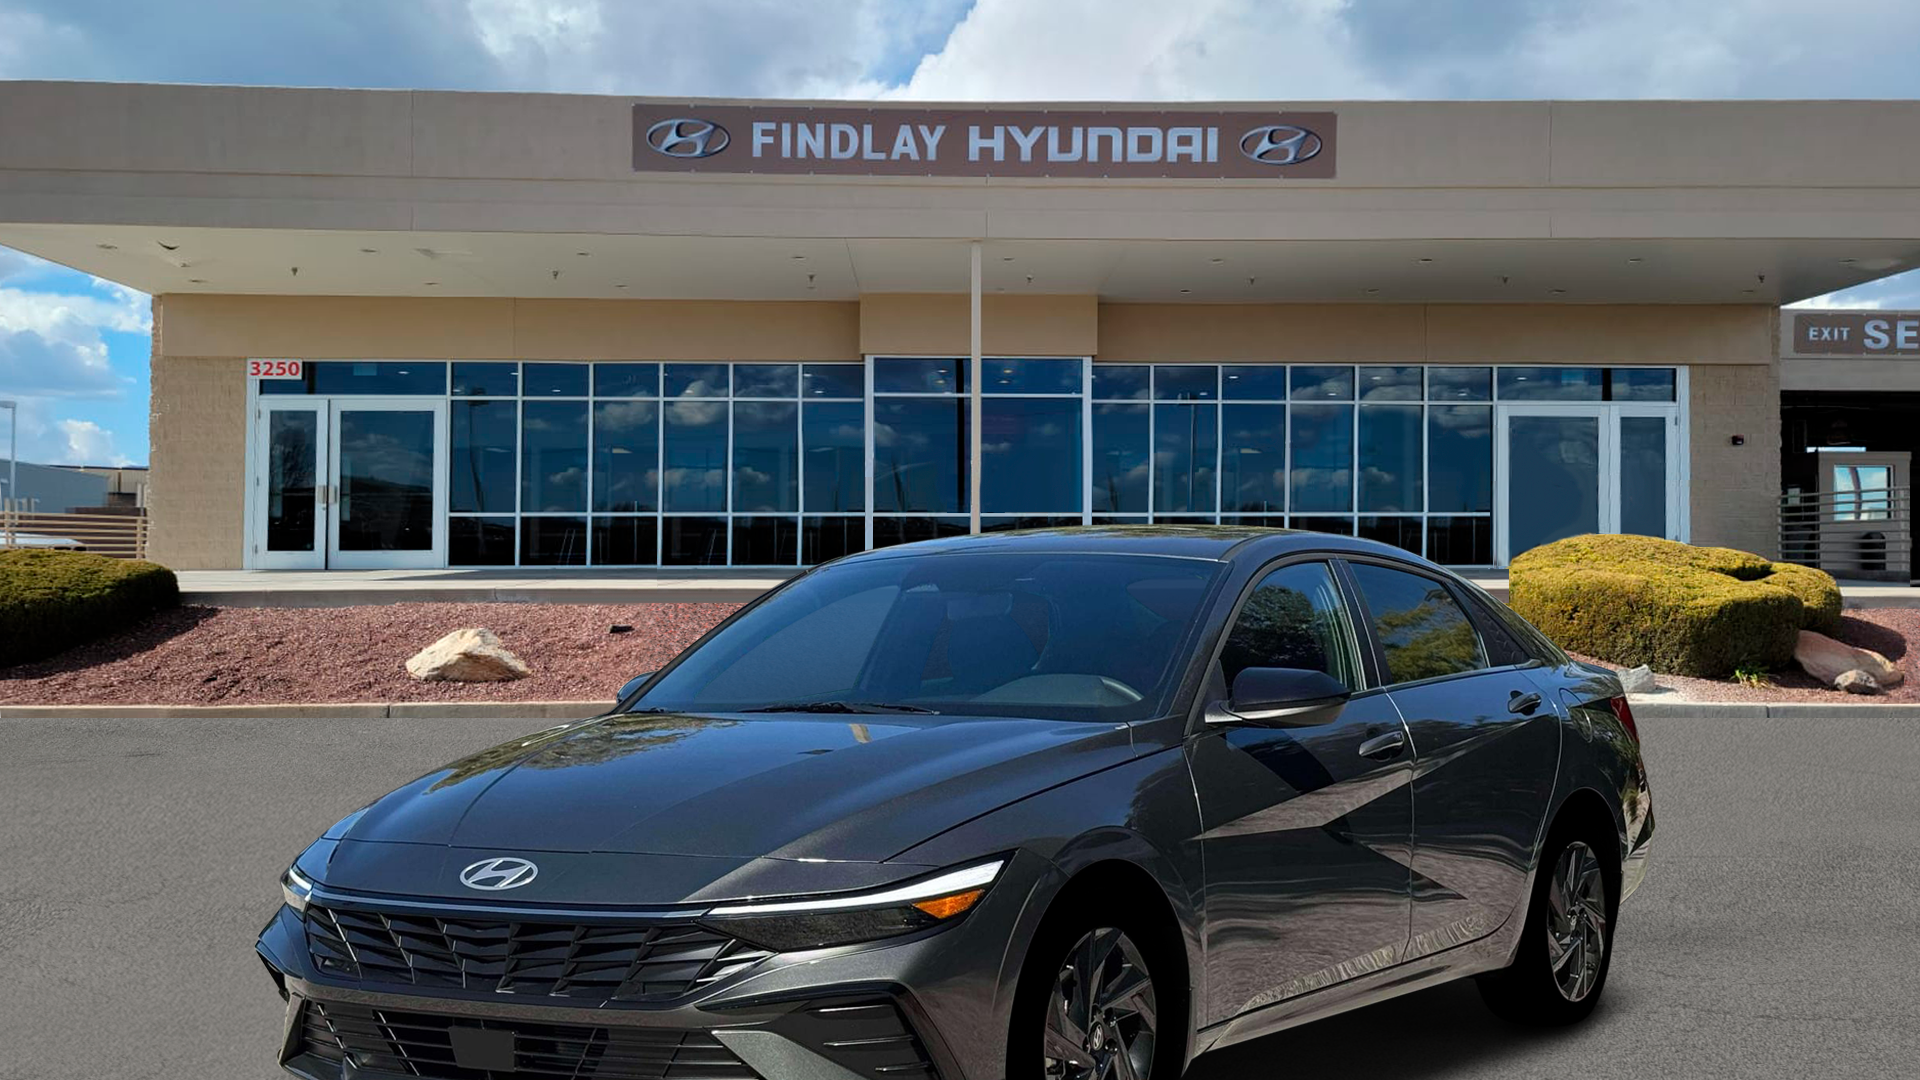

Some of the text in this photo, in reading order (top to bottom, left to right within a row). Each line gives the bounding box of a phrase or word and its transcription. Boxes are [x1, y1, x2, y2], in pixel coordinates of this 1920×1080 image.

[751, 121, 1219, 163] FINDLAY HYUNDAI
[1808, 319, 1920, 350] EXIT SE
[250, 361, 300, 376] 3250
